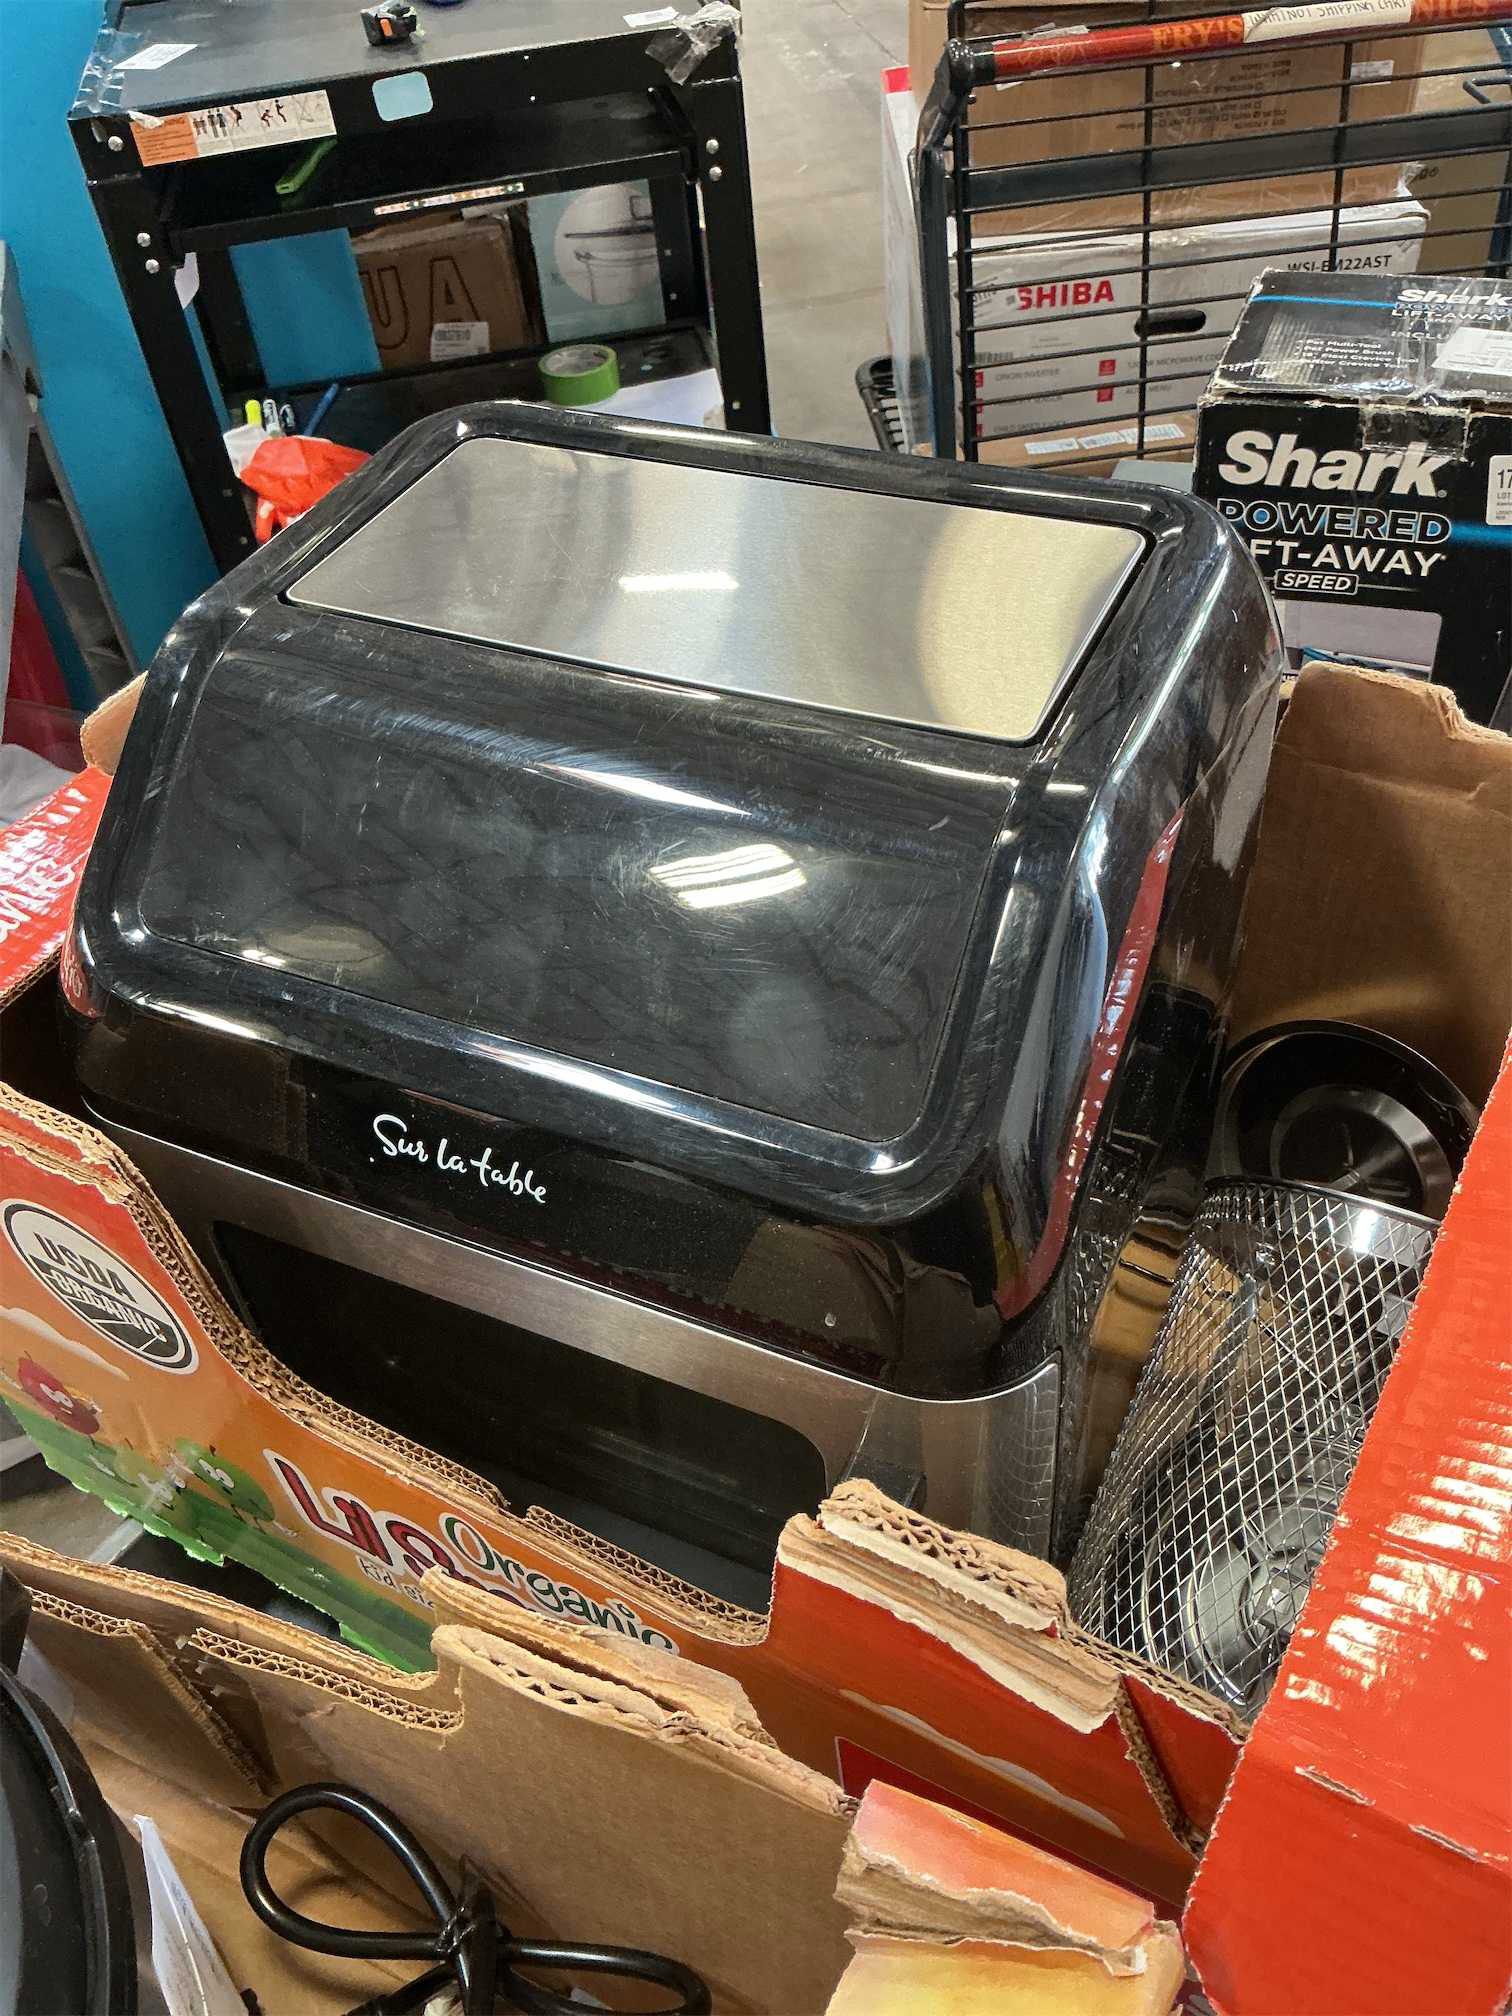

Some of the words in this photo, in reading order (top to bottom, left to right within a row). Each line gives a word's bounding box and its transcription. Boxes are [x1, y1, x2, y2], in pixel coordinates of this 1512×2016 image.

[1397, 289, 1512, 306] Shark
[1218, 430, 1451, 497] Shark
[1217, 498, 1451, 544] POWERED
[1282, 573, 1351, 592] SPEED
[373, 1114, 429, 1162] Sur
[437, 1138, 467, 1173] la
[470, 1148, 547, 1204] table
[34, 1232, 137, 1304] USDA
[46, 1270, 168, 1343] ORGANIC
